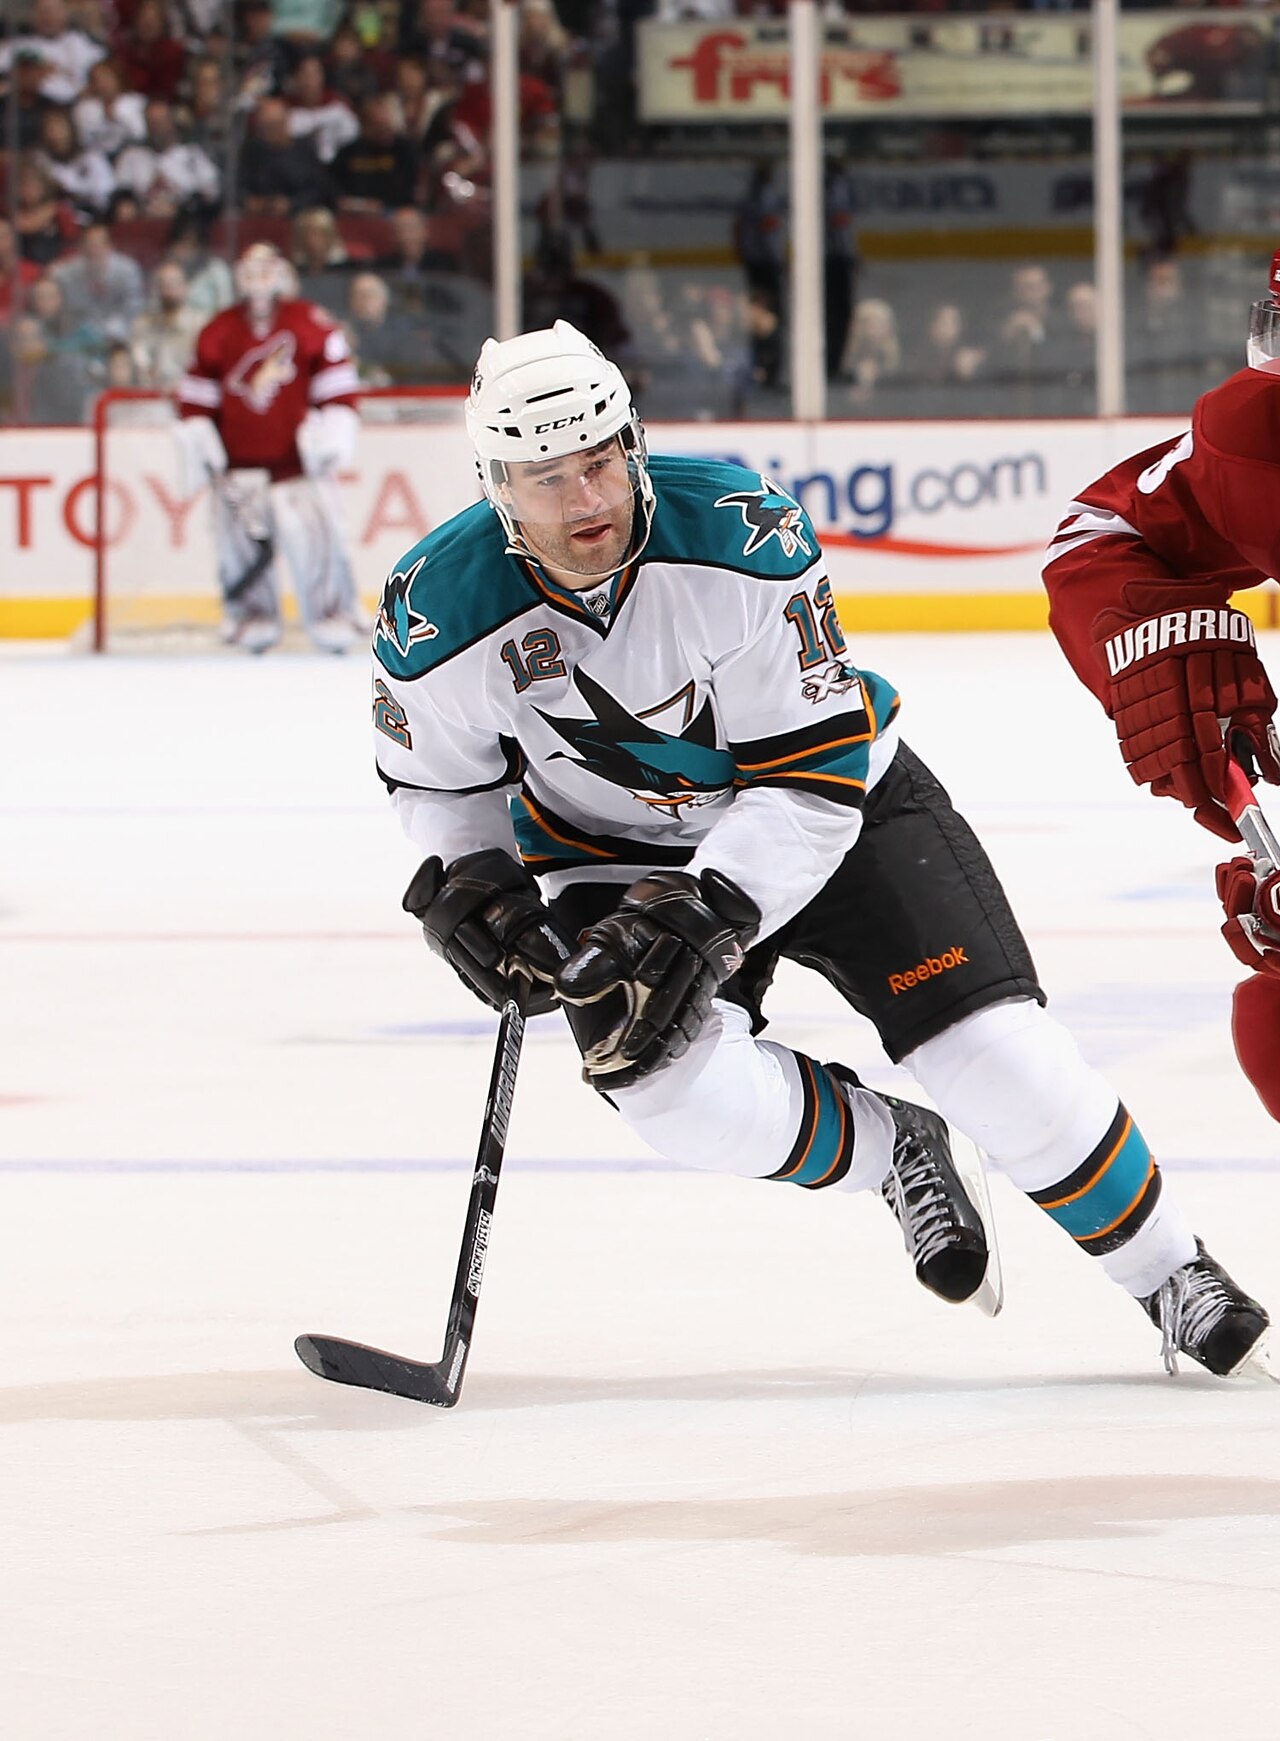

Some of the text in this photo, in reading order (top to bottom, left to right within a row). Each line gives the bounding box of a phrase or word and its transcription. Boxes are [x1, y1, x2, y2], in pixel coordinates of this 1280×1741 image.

[535, 413, 586, 434] CCM
[0, 468, 432, 550] TOYA
[500, 627, 568, 694] 12
[888, 946, 970, 995] Reebok
